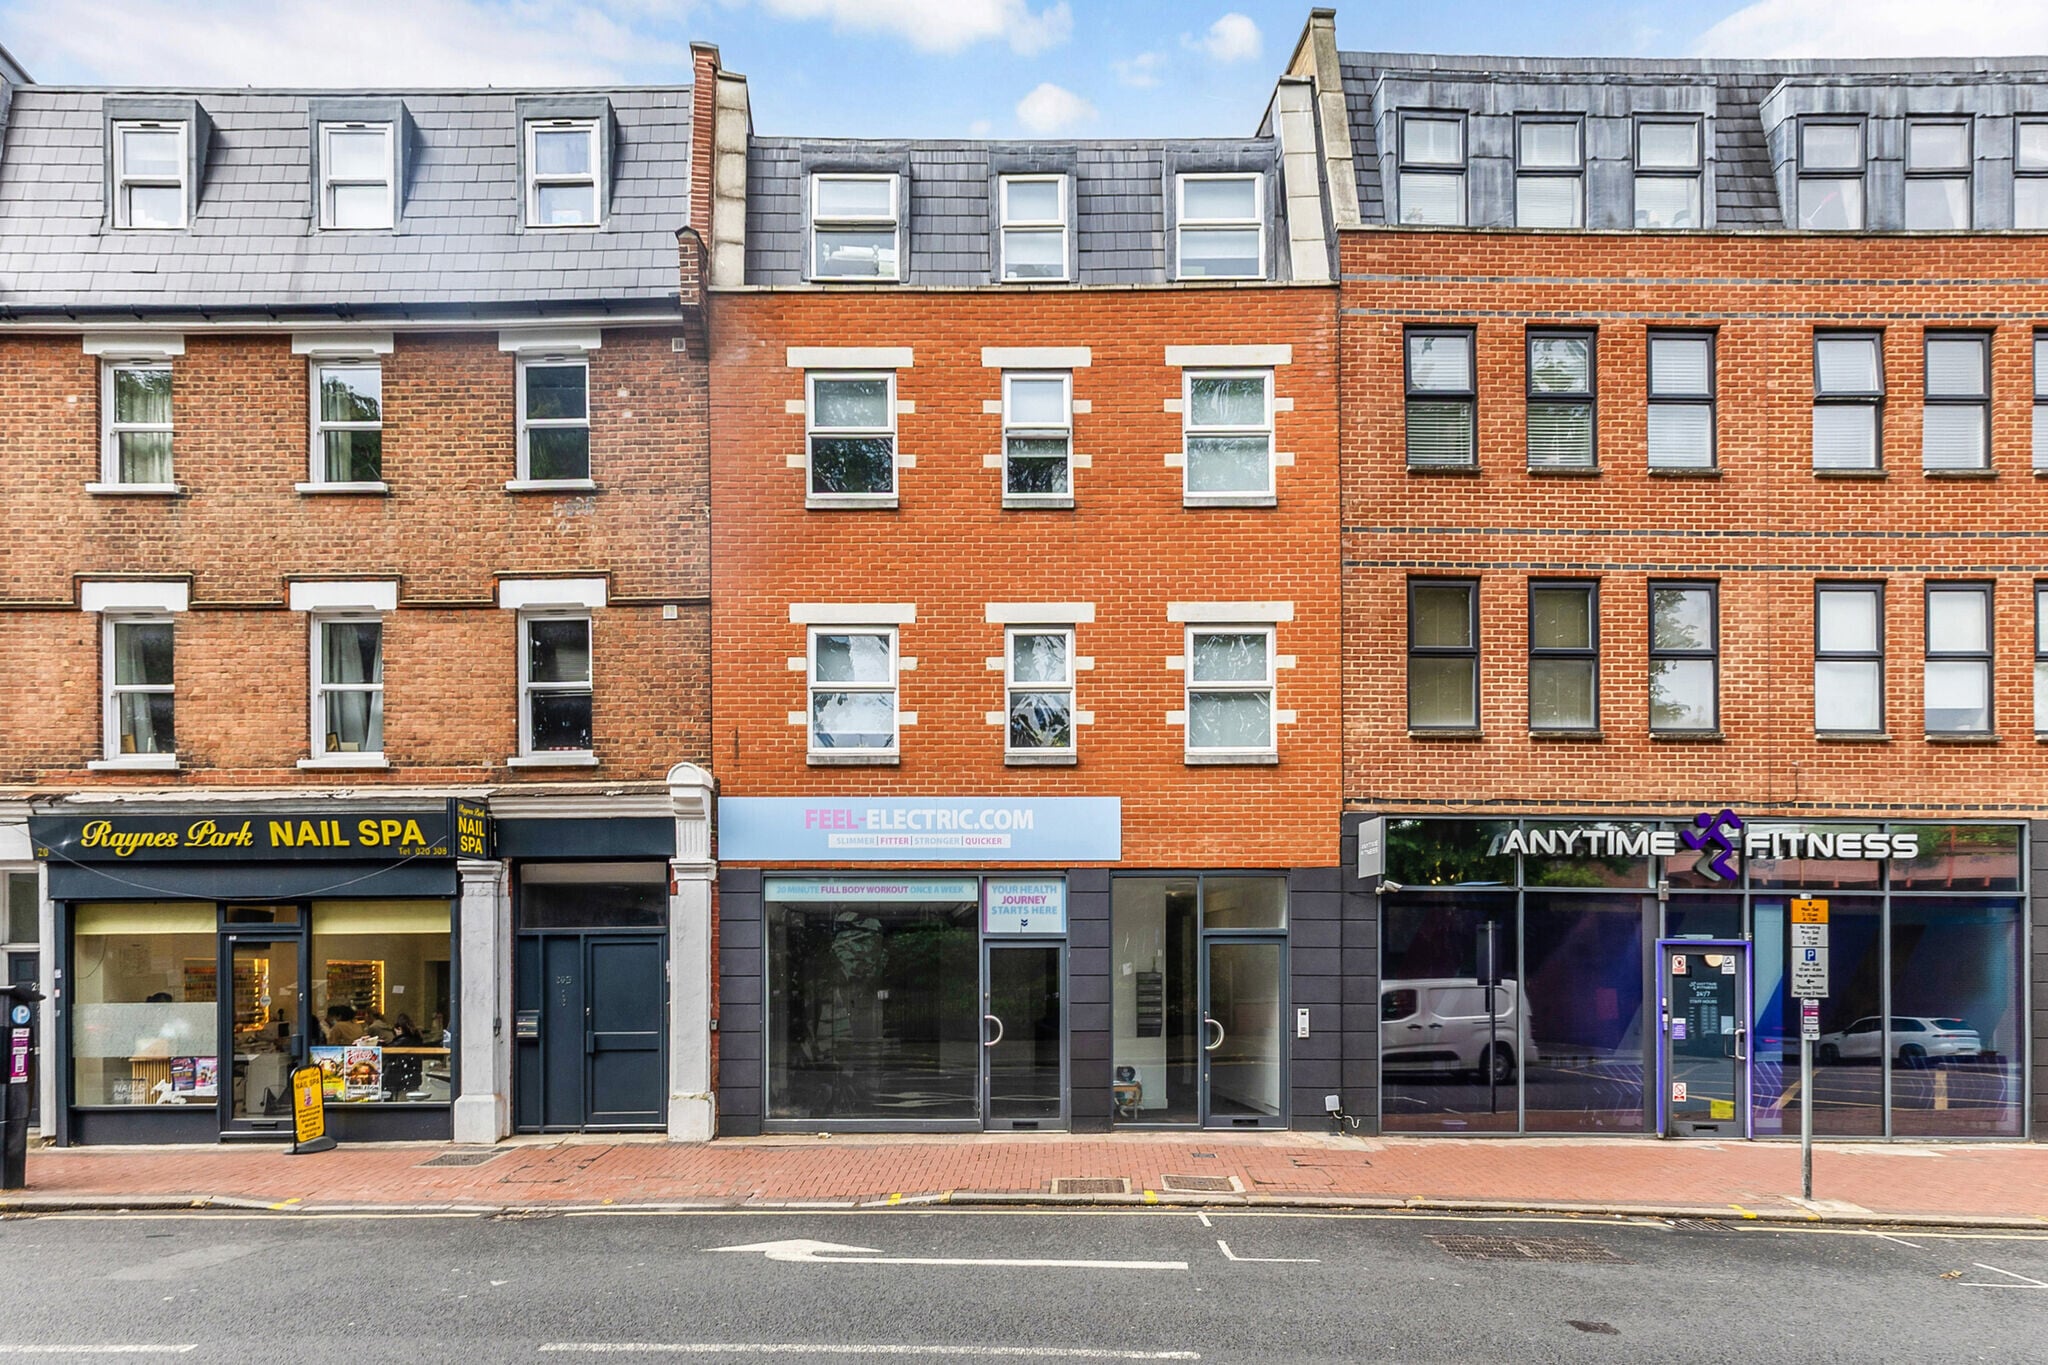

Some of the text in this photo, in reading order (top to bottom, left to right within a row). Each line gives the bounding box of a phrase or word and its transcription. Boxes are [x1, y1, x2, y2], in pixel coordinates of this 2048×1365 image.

[805, 808, 1034, 830] FEEL-ELECTRIC.COM
[458, 816, 485, 837] NAIL
[80, 819, 427, 858] Raynes Park NAIL SPA
[460, 835, 483, 855] SPA
[836, 837, 1002, 845] SLIMMER FITTER STRONGER QUICKER
[1502, 829, 1919, 859] ANYTIME FITNESS
[776, 886, 964, 894] 20 MINUTE FULL BODY WORKOUT ONCE A WEEK
[992, 885, 1057, 894] YOUR HEALTH
[1001, 895, 1047, 905] JOURNEY
[992, 906, 1057, 915] STARTS HERE
[1807, 950, 1815, 960] P
[17, 1007, 26, 1023] P
